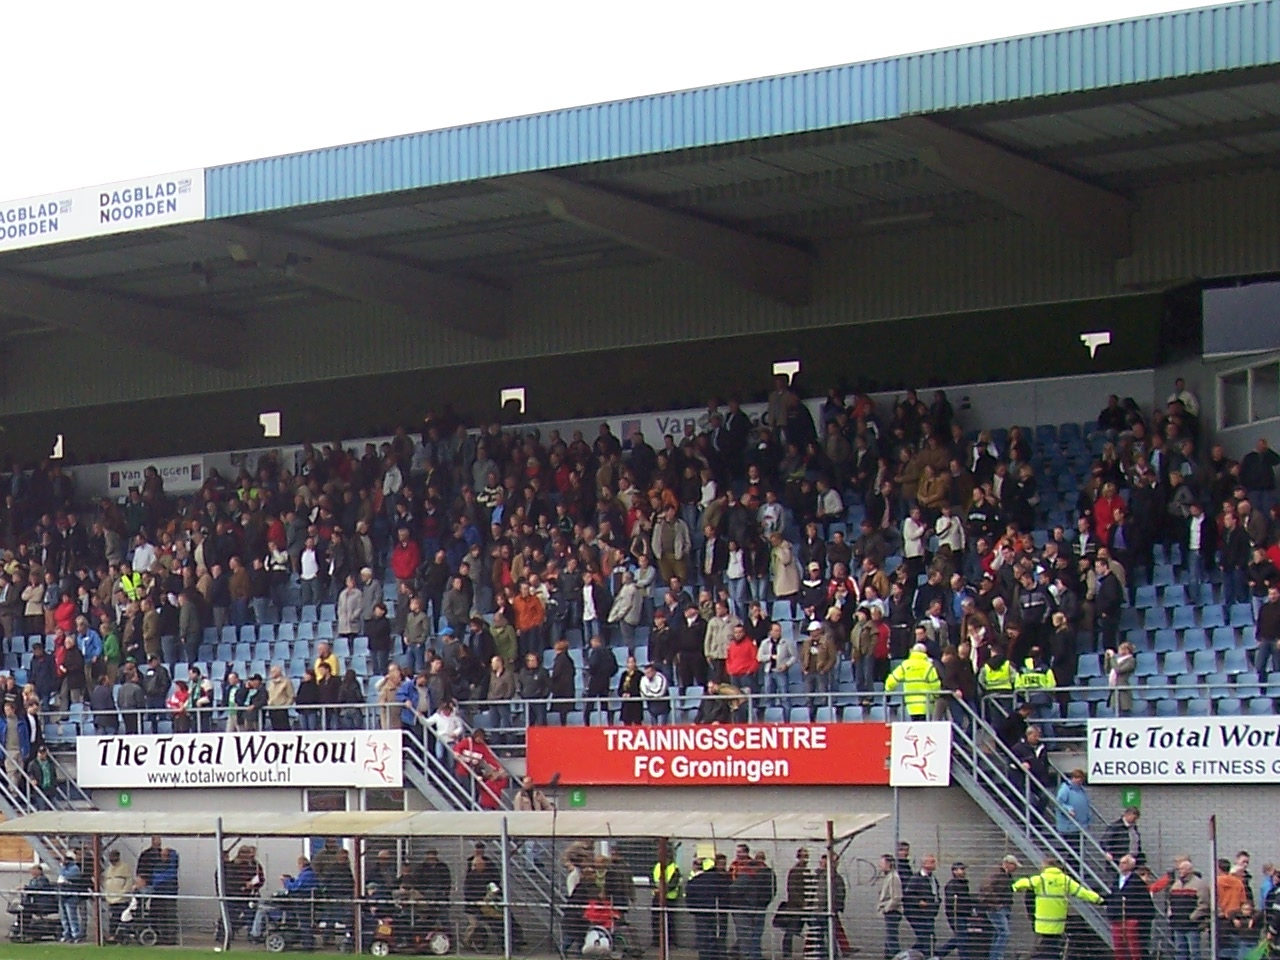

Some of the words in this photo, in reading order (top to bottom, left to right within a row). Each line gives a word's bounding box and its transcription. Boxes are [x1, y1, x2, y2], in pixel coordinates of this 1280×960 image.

[99, 181, 176, 207] DAGBLAD
[100, 198, 177, 224] NOORDEN
[603, 726, 827, 751] TRAININGSCENTRE
[1091, 726, 1140, 750] The
[1146, 725, 1211, 749] Total
[97, 736, 148, 767] The
[155, 735, 224, 766] Total
[233, 734, 357, 766] Workout
[146, 767, 292, 784] www.totalworkout.nl
[634, 756, 664, 777] FC
[670, 756, 789, 783] Groningen
[1091, 760, 1170, 776] AEROBIC
[1174, 760, 1187, 775] &
[1192, 759, 1266, 775] FITNESS
[1126, 792, 1135, 803] F
